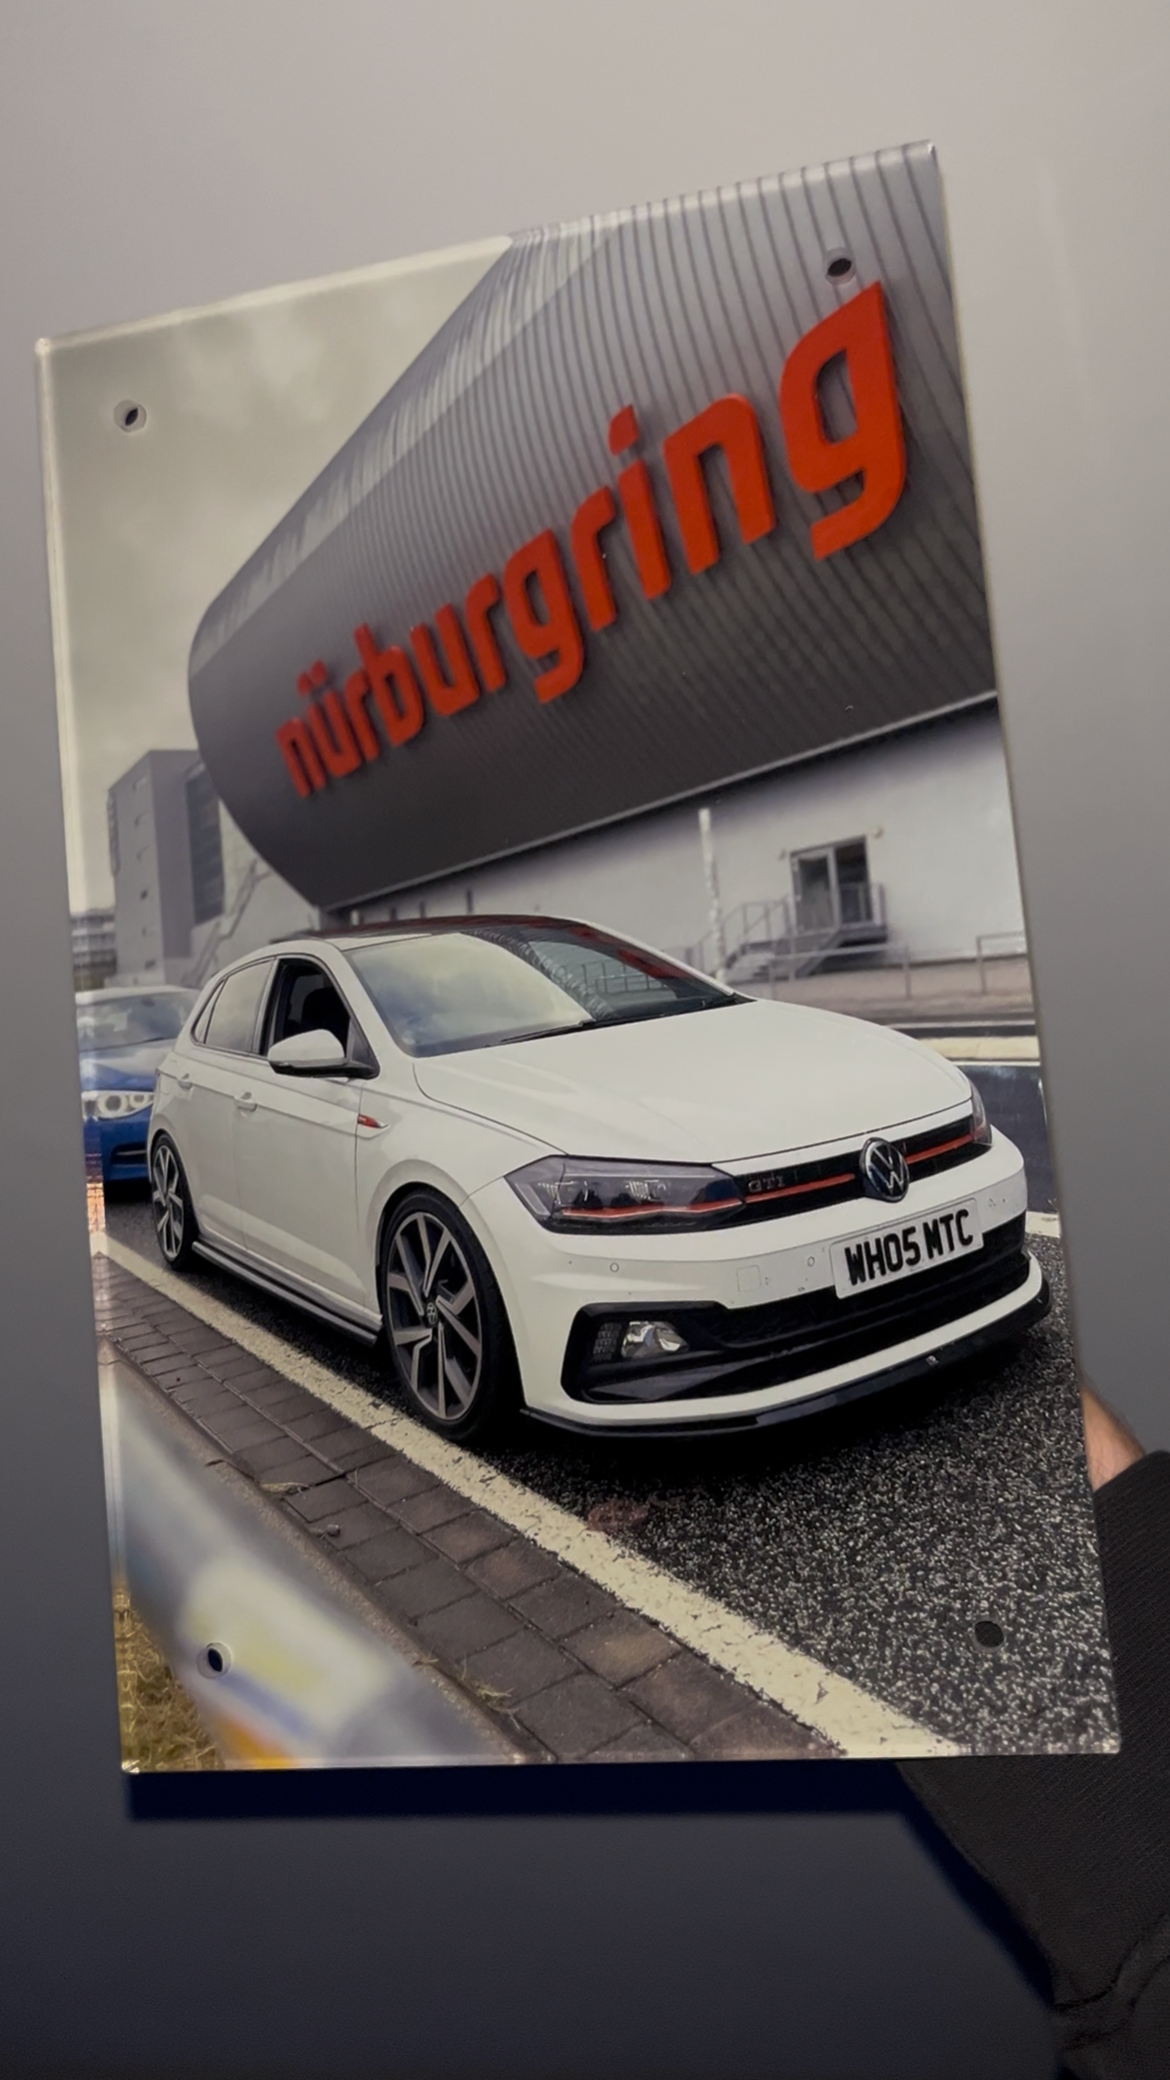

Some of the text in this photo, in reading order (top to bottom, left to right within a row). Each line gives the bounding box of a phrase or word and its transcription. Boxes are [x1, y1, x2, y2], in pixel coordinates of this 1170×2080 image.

[275, 280, 906, 798] nürburgring
[748, 1175, 786, 1193] GTI
[844, 1208, 974, 1287] WH05 MTC
